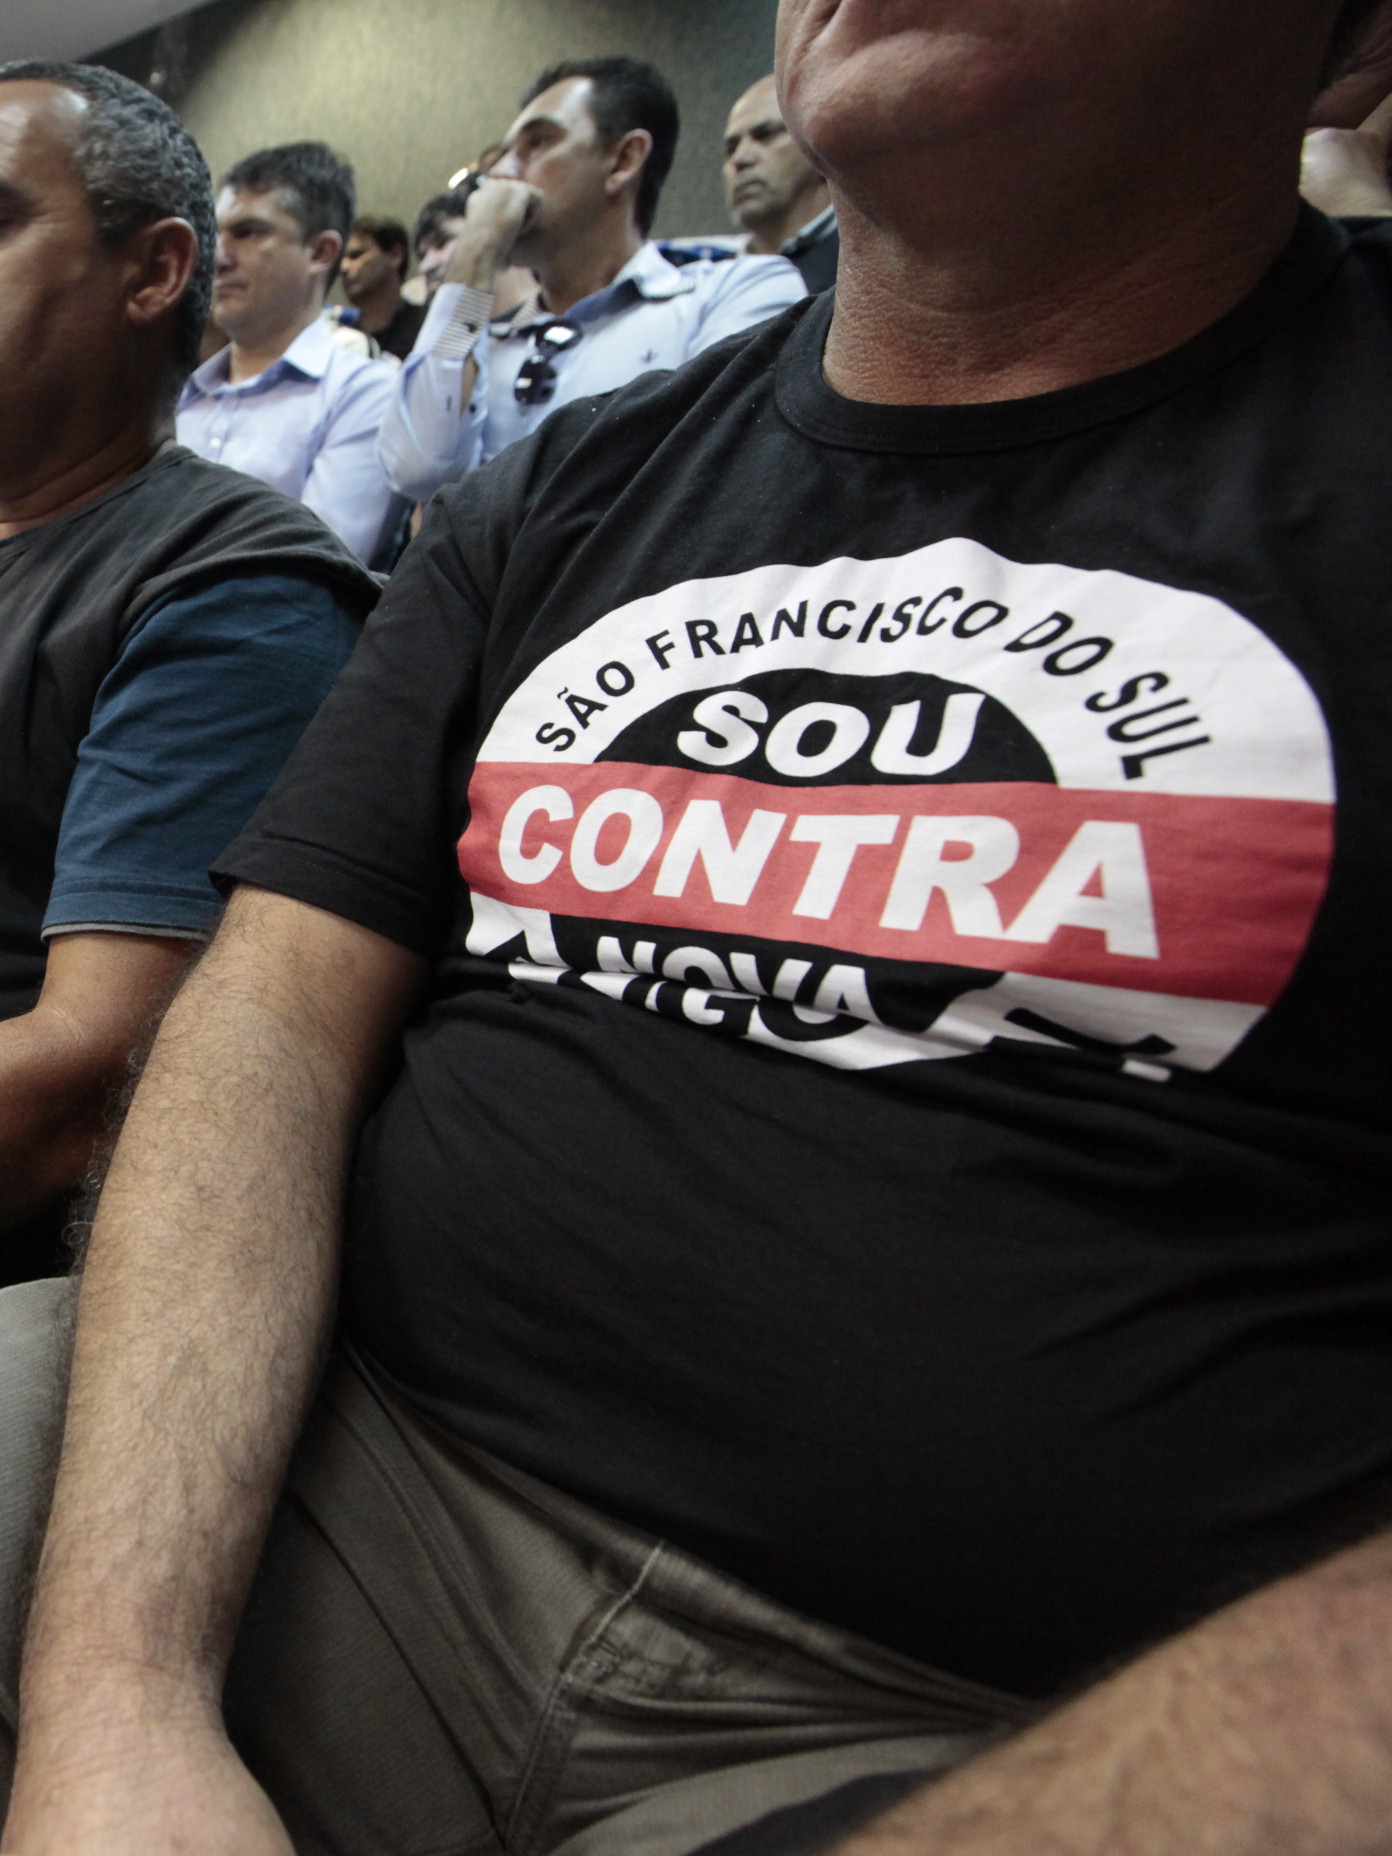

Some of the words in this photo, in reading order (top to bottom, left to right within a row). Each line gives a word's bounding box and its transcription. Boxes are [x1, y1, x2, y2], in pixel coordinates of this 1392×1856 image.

[536, 659, 635, 752] SÃO
[646, 586, 1008, 671] FRANCISCO
[1004, 611, 1114, 676] DO
[1085, 672, 1212, 780] SUL
[677, 691, 986, 777] SOU
[498, 785, 1161, 960] CONTRA
